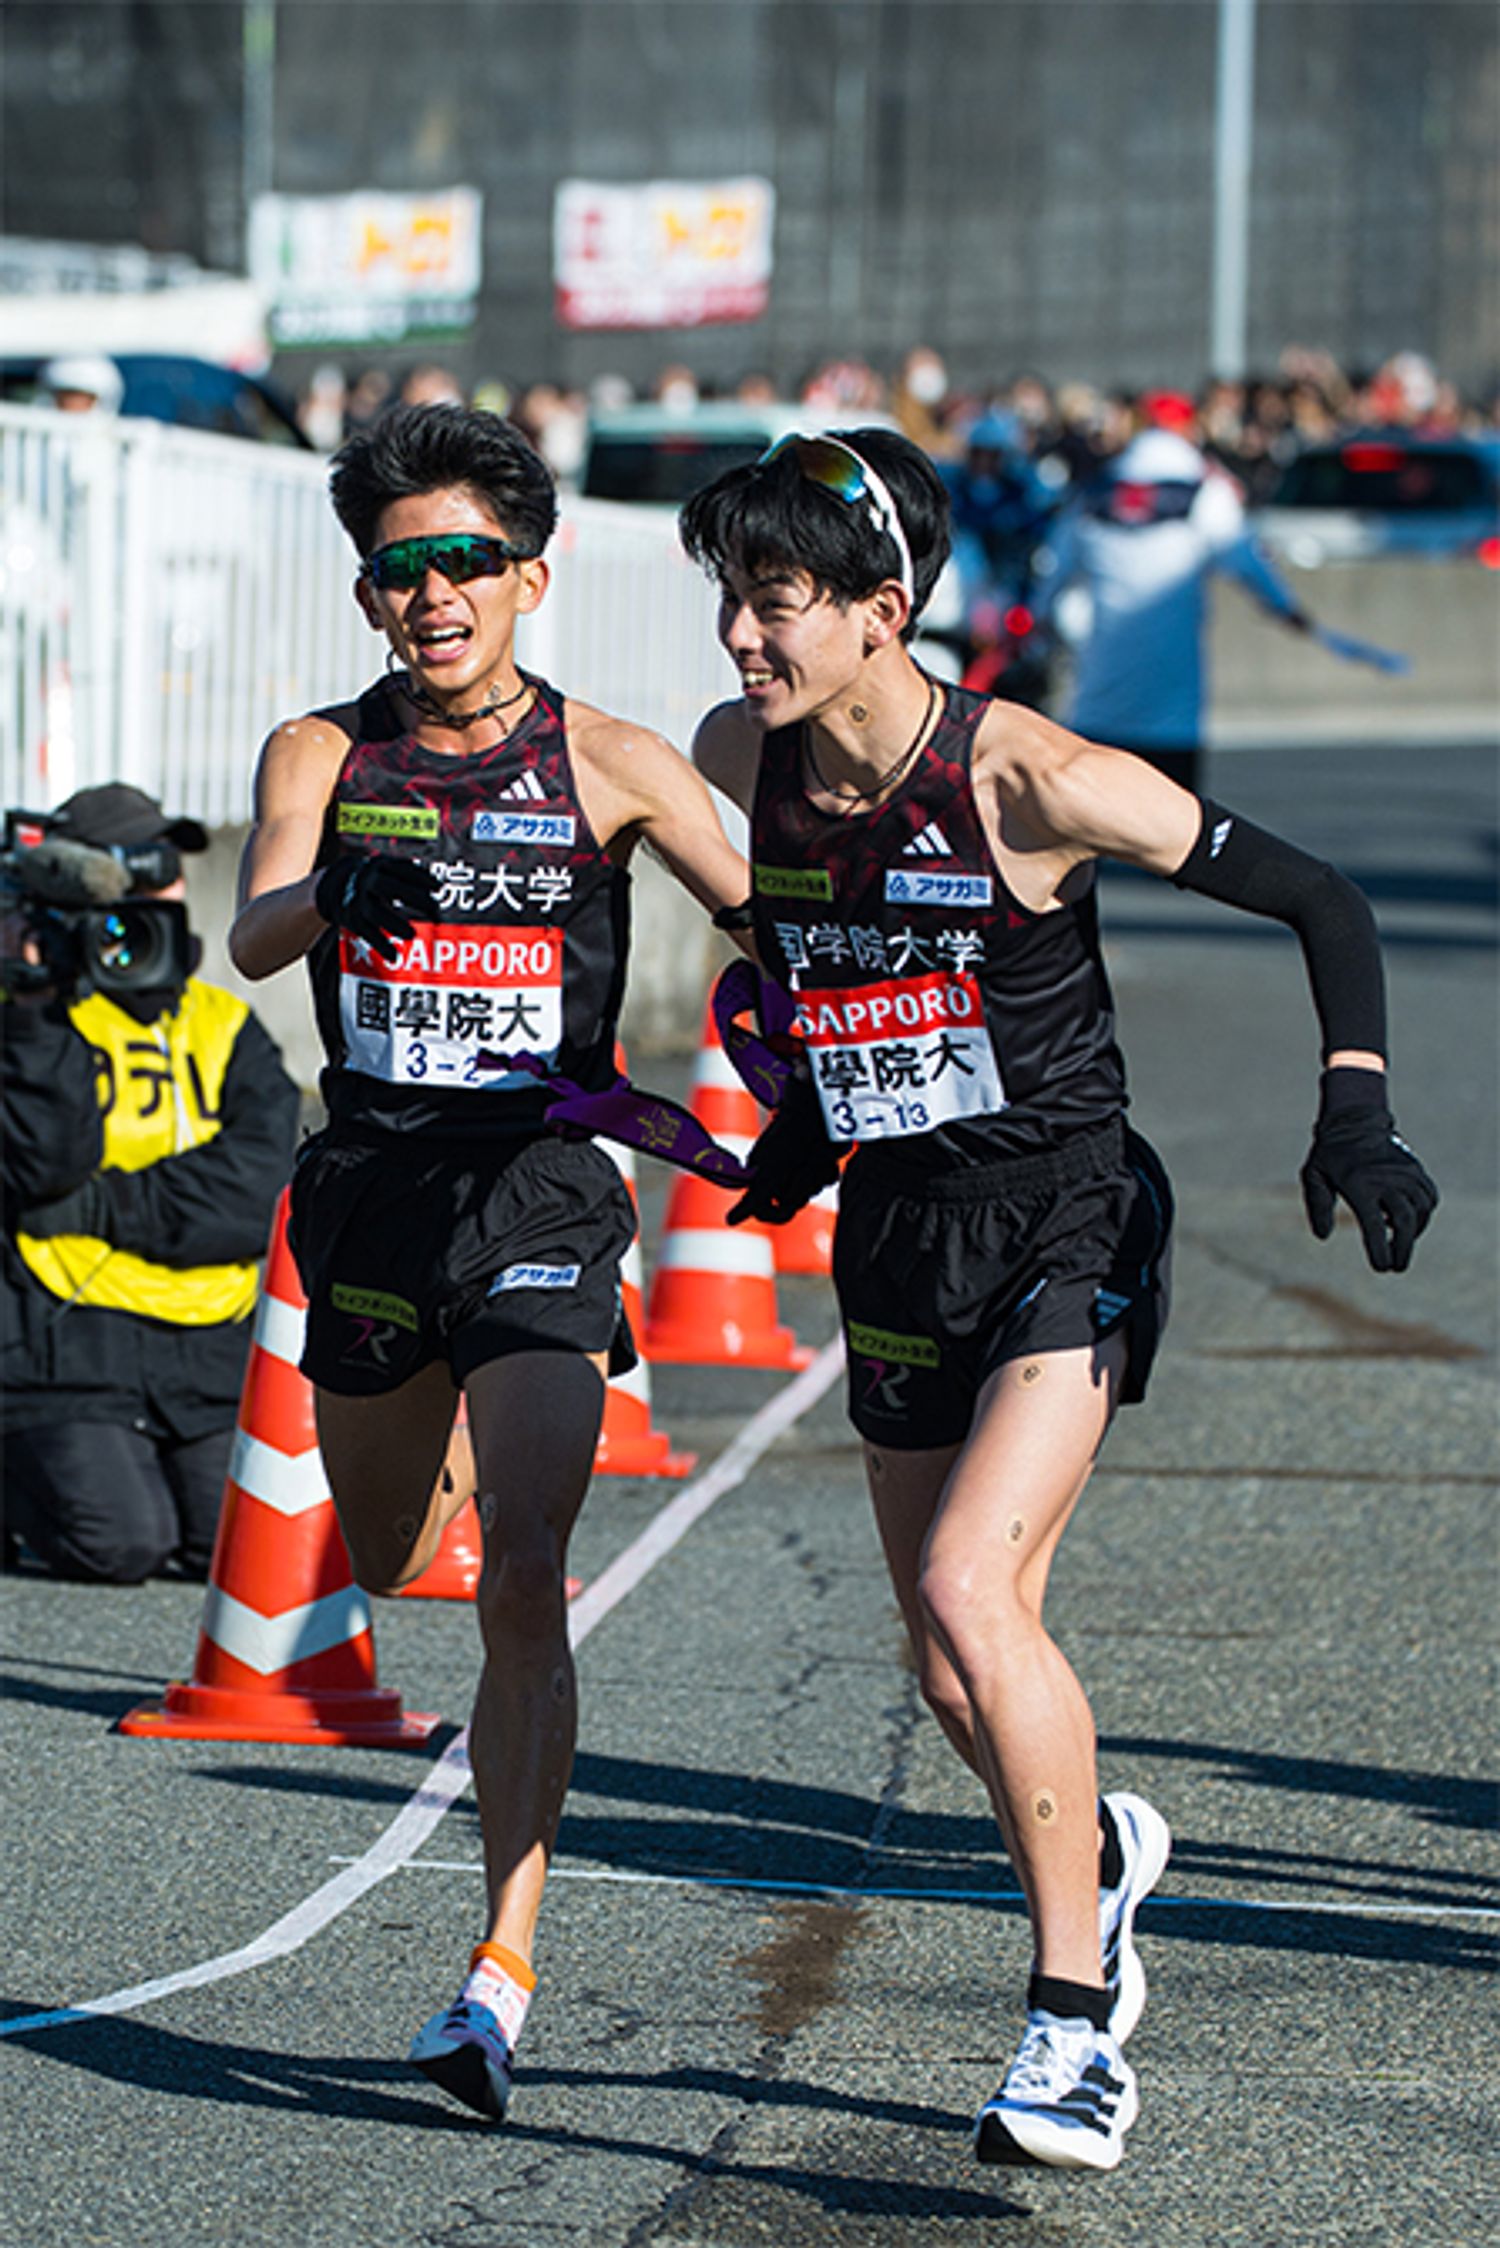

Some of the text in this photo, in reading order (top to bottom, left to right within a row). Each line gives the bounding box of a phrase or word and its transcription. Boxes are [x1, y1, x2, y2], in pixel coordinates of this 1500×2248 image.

[503, 816, 571, 840] アサガミ
[393, 856, 572, 912] 院大学
[916, 876, 988, 900] アサガミ
[383, 934, 554, 977] SAPPORO
[356, 980, 542, 1042] 國學院大
[795, 985, 972, 1036] SAPPORO
[818, 1033, 975, 1097] 學院大
[832, 1100, 929, 1135] 3-13
